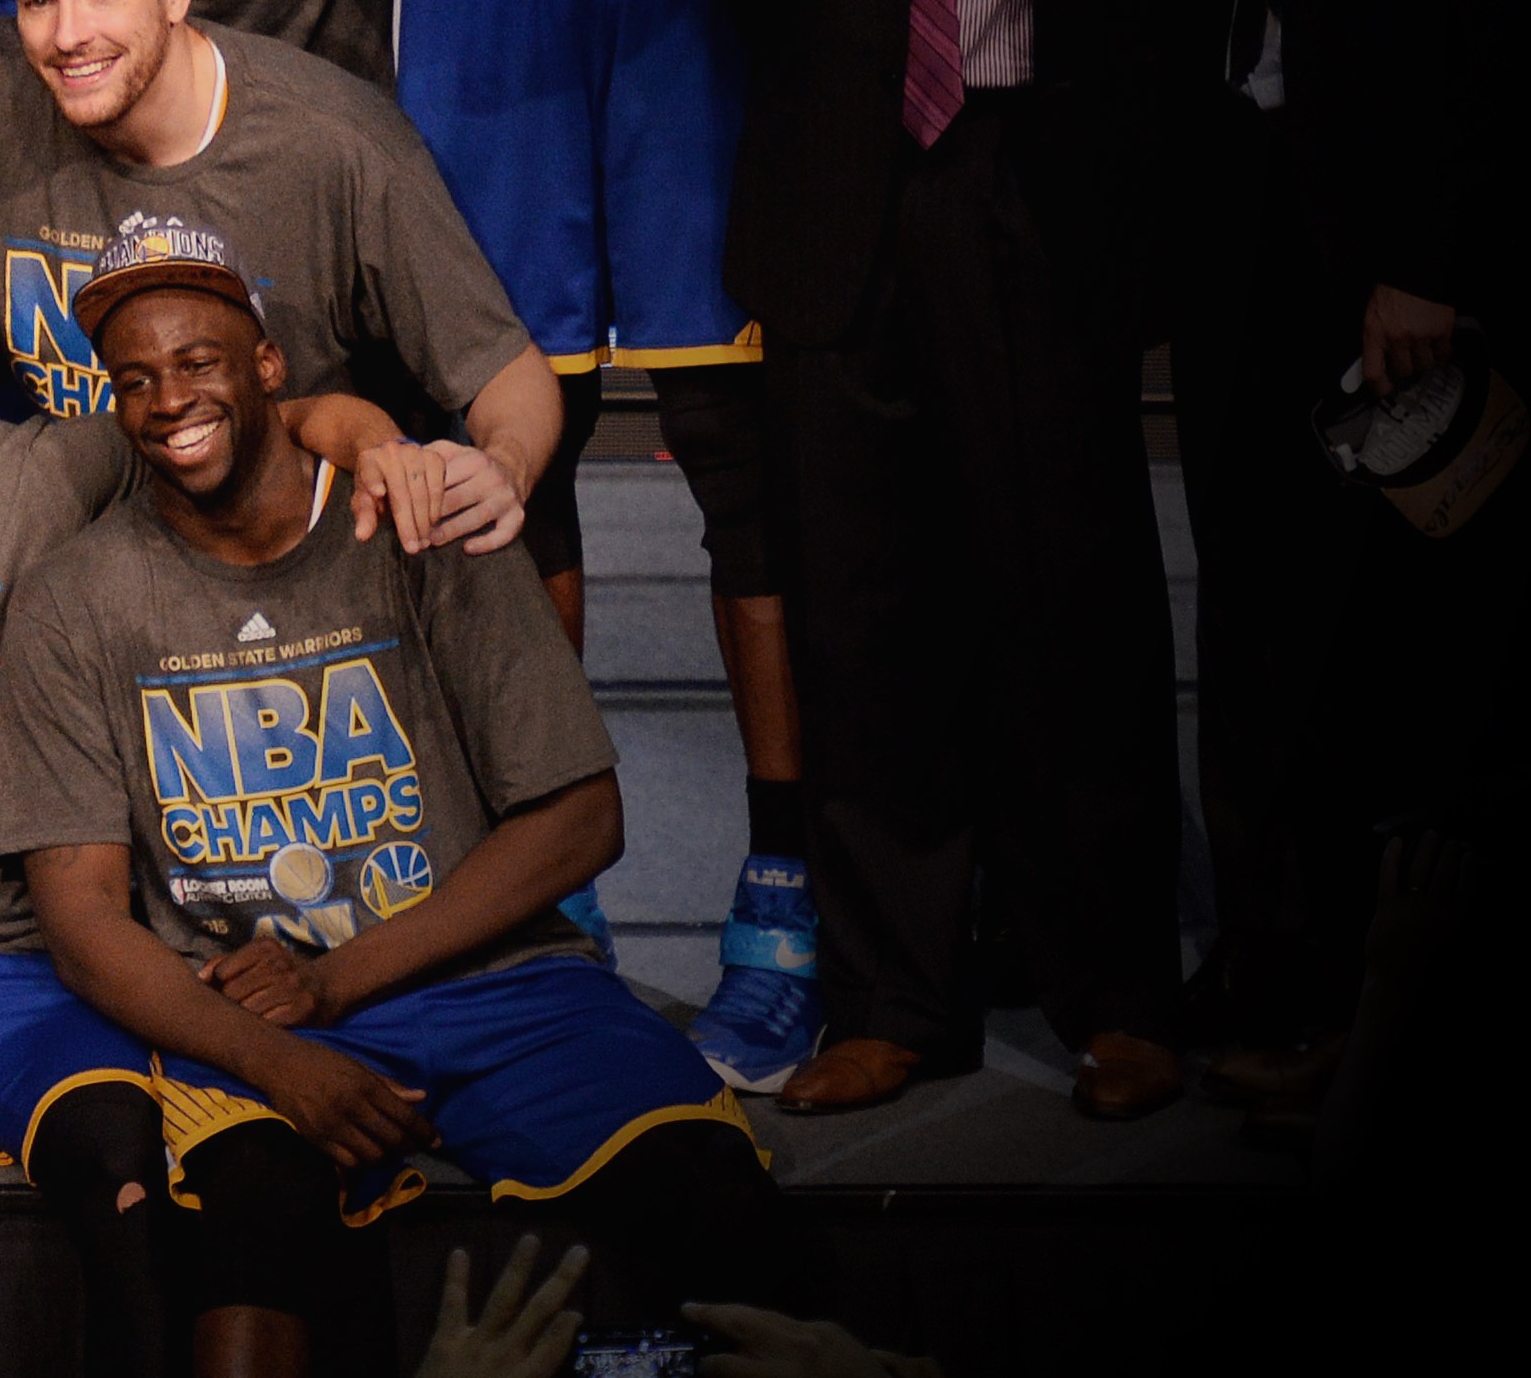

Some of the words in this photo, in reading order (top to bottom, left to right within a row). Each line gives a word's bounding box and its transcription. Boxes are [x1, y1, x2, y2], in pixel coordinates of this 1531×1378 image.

[39, 225, 104, 250] GOLDEN
[159, 653, 225, 672] GOLDEN
[226, 648, 276, 666] STATE
[279, 627, 363, 660] WARRIORS
[141, 658, 416, 805] NBA
[162, 770, 423, 863] CHAMPS
